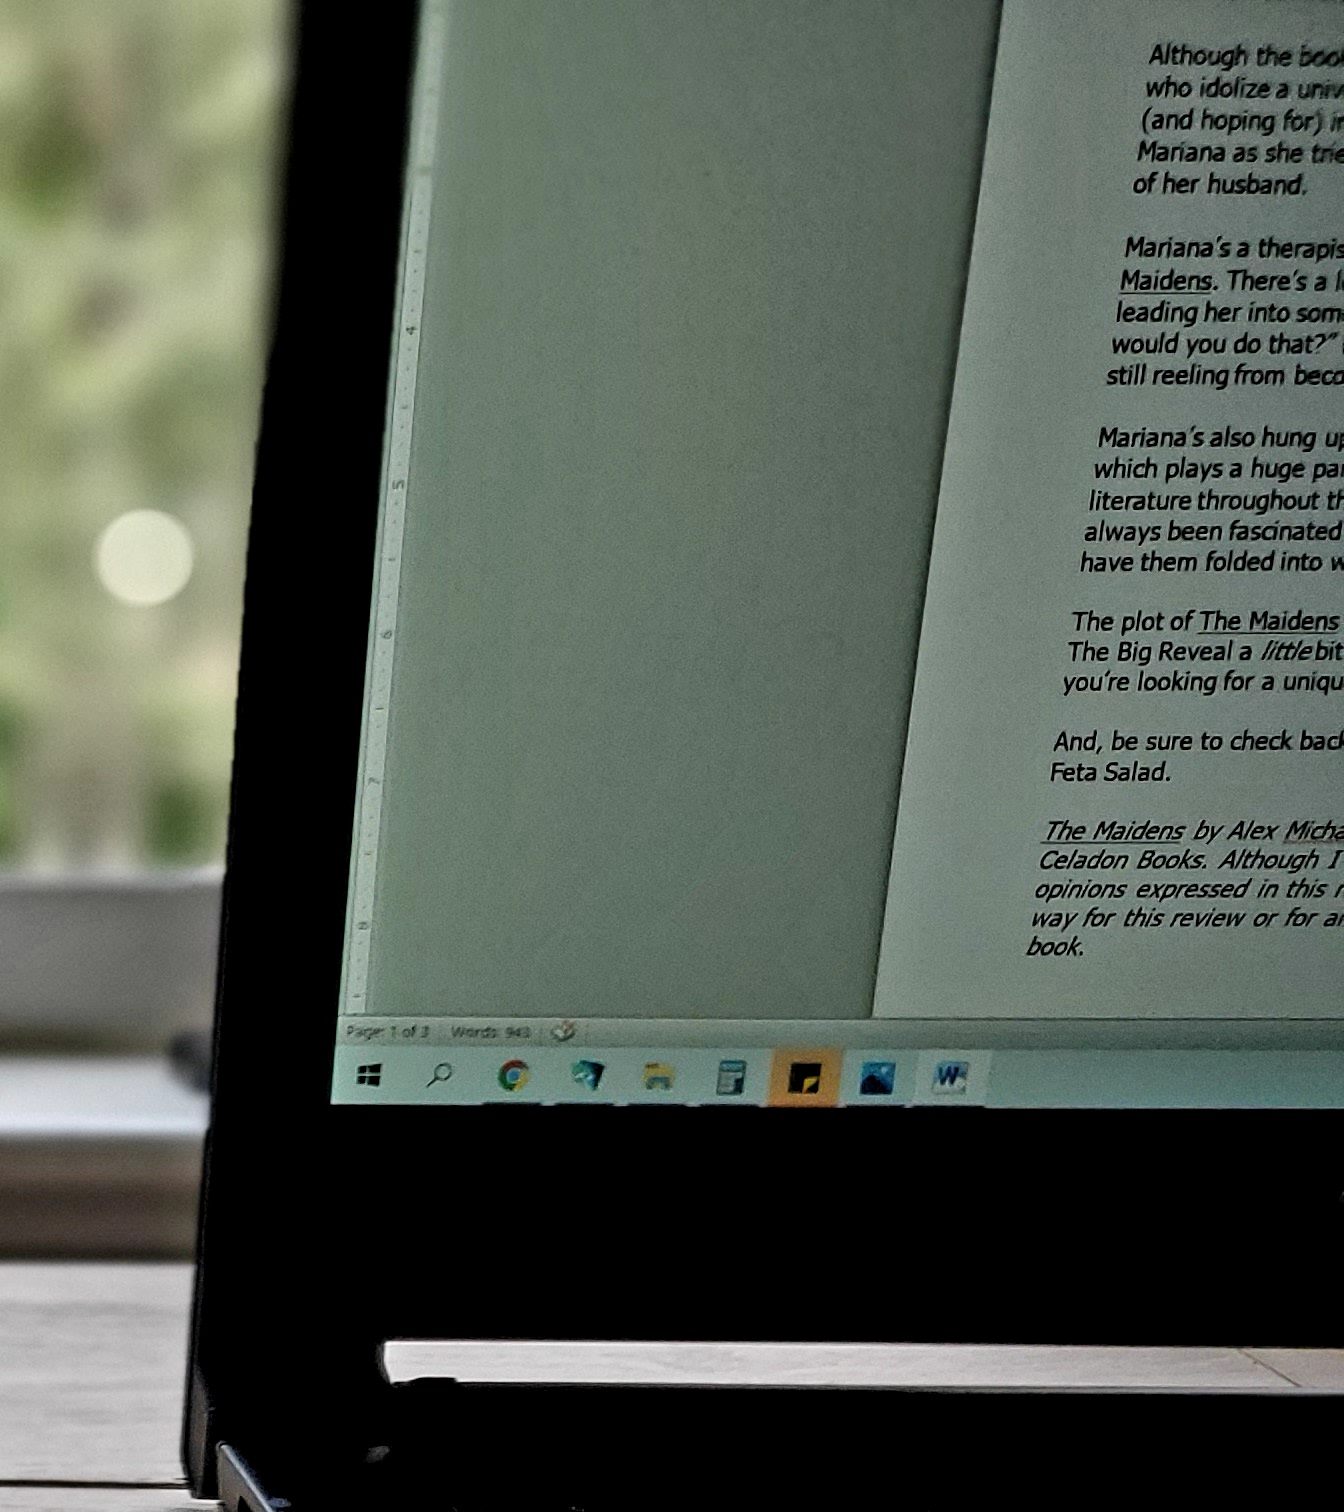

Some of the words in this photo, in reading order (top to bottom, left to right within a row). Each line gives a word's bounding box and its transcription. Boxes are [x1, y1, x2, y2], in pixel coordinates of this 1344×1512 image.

[1148, 41, 1250, 72] Although
[1256, 43, 1293, 68] the
[1145, 74, 1193, 99] who
[1199, 75, 1272, 99] idolize
[1275, 81, 1291, 100] a
[1141, 105, 1195, 135] (and
[1200, 107, 1277, 137] hoping
[1282, 107, 1325, 137] for)
[1136, 139, 1227, 163] Mariana
[1232, 145, 1259, 164] as
[1264, 140, 1305, 164] she
[1132, 171, 1158, 195] of
[1162, 170, 1202, 195] her
[1206, 171, 1308, 196] husband.
[1124, 235, 1232, 260] Mariana's
[1235, 241, 1251, 258] a
[1118, 267, 1219, 296] Maidens.
[1226, 268, 1309, 292] There's
[1313, 275, 1328, 292] a
[1116, 299, 1200, 328] leading
[1202, 299, 1243, 323] her
[1247, 301, 1291, 324] into
[1295, 306, 1344, 324] som
[1111, 331, 1180, 355] would
[1186, 337, 1228, 360] you
[1233, 331, 1262, 355] do
[1106, 362, 1147, 386] still
[1151, 362, 1230, 391] reeling
[1233, 362, 1286, 386] from
[1098, 424, 1205, 449] Mariana's
[1208, 425, 1256, 448] also
[1260, 424, 1317, 453] hung
[1093, 455, 1159, 479] which
[1164, 455, 1225, 485] plays
[1228, 462, 1243, 479] a
[1250, 455, 1306, 484] huge
[1088, 488, 1193, 512] literature
[1197, 487, 1321, 516] throughout
[1084, 518, 1163, 547] always
[1167, 519, 1223, 542] been
[1228, 519, 1344, 542] fascinated
[1080, 550, 1135, 573] have
[1140, 549, 1198, 573] them
[1204, 549, 1276, 572] folded
[1280, 551, 1324, 572] into
[1071, 609, 1115, 632] The
[1120, 609, 1166, 637] plot
[1169, 609, 1197, 632] of
[1196, 609, 1243, 636] The
[1246, 608, 1341, 635] Maidens
[1067, 639, 1110, 663] The
[1117, 640, 1153, 667] Big
[1158, 639, 1234, 662] Reveal
[1238, 645, 1253, 661] a
[1260, 639, 1314, 661] little
[1314, 639, 1344, 661] bit
[1063, 669, 1130, 697] you're
[1137, 669, 1219, 697] looking
[1223, 669, 1256, 692] for
[1261, 675, 1275, 691] a
[1052, 729, 1103, 756] And,
[1111, 729, 1139, 752] be
[1145, 735, 1193, 751] sure
[1200, 731, 1224, 751] to
[1229, 727, 1294, 751] check
[1050, 761, 1098, 783] Feta
[1103, 760, 1171, 782] Salad.
[1039, 819, 1089, 845] The
[1089, 819, 1188, 845] Maidens
[1190, 819, 1224, 846] by
[1225, 819, 1281, 841] Alex
[1039, 848, 1130, 870] Celadon
[1135, 848, 1207, 870] Books.
[1216, 847, 1320, 875] Although
[1327, 849, 1344, 870] I
[1034, 878, 1129, 904] opinions
[1135, 877, 1253, 904] expressed
[1256, 878, 1280, 899] in
[1285, 877, 1328, 899] this
[1031, 912, 1080, 934] way
[1081, 906, 1118, 928] for
[1123, 905, 1164, 928] this
[1169, 907, 1248, 928] review
[1252, 912, 1280, 928] or
[1283, 906, 1320, 928] for
[1025, 935, 1084, 957] book.
